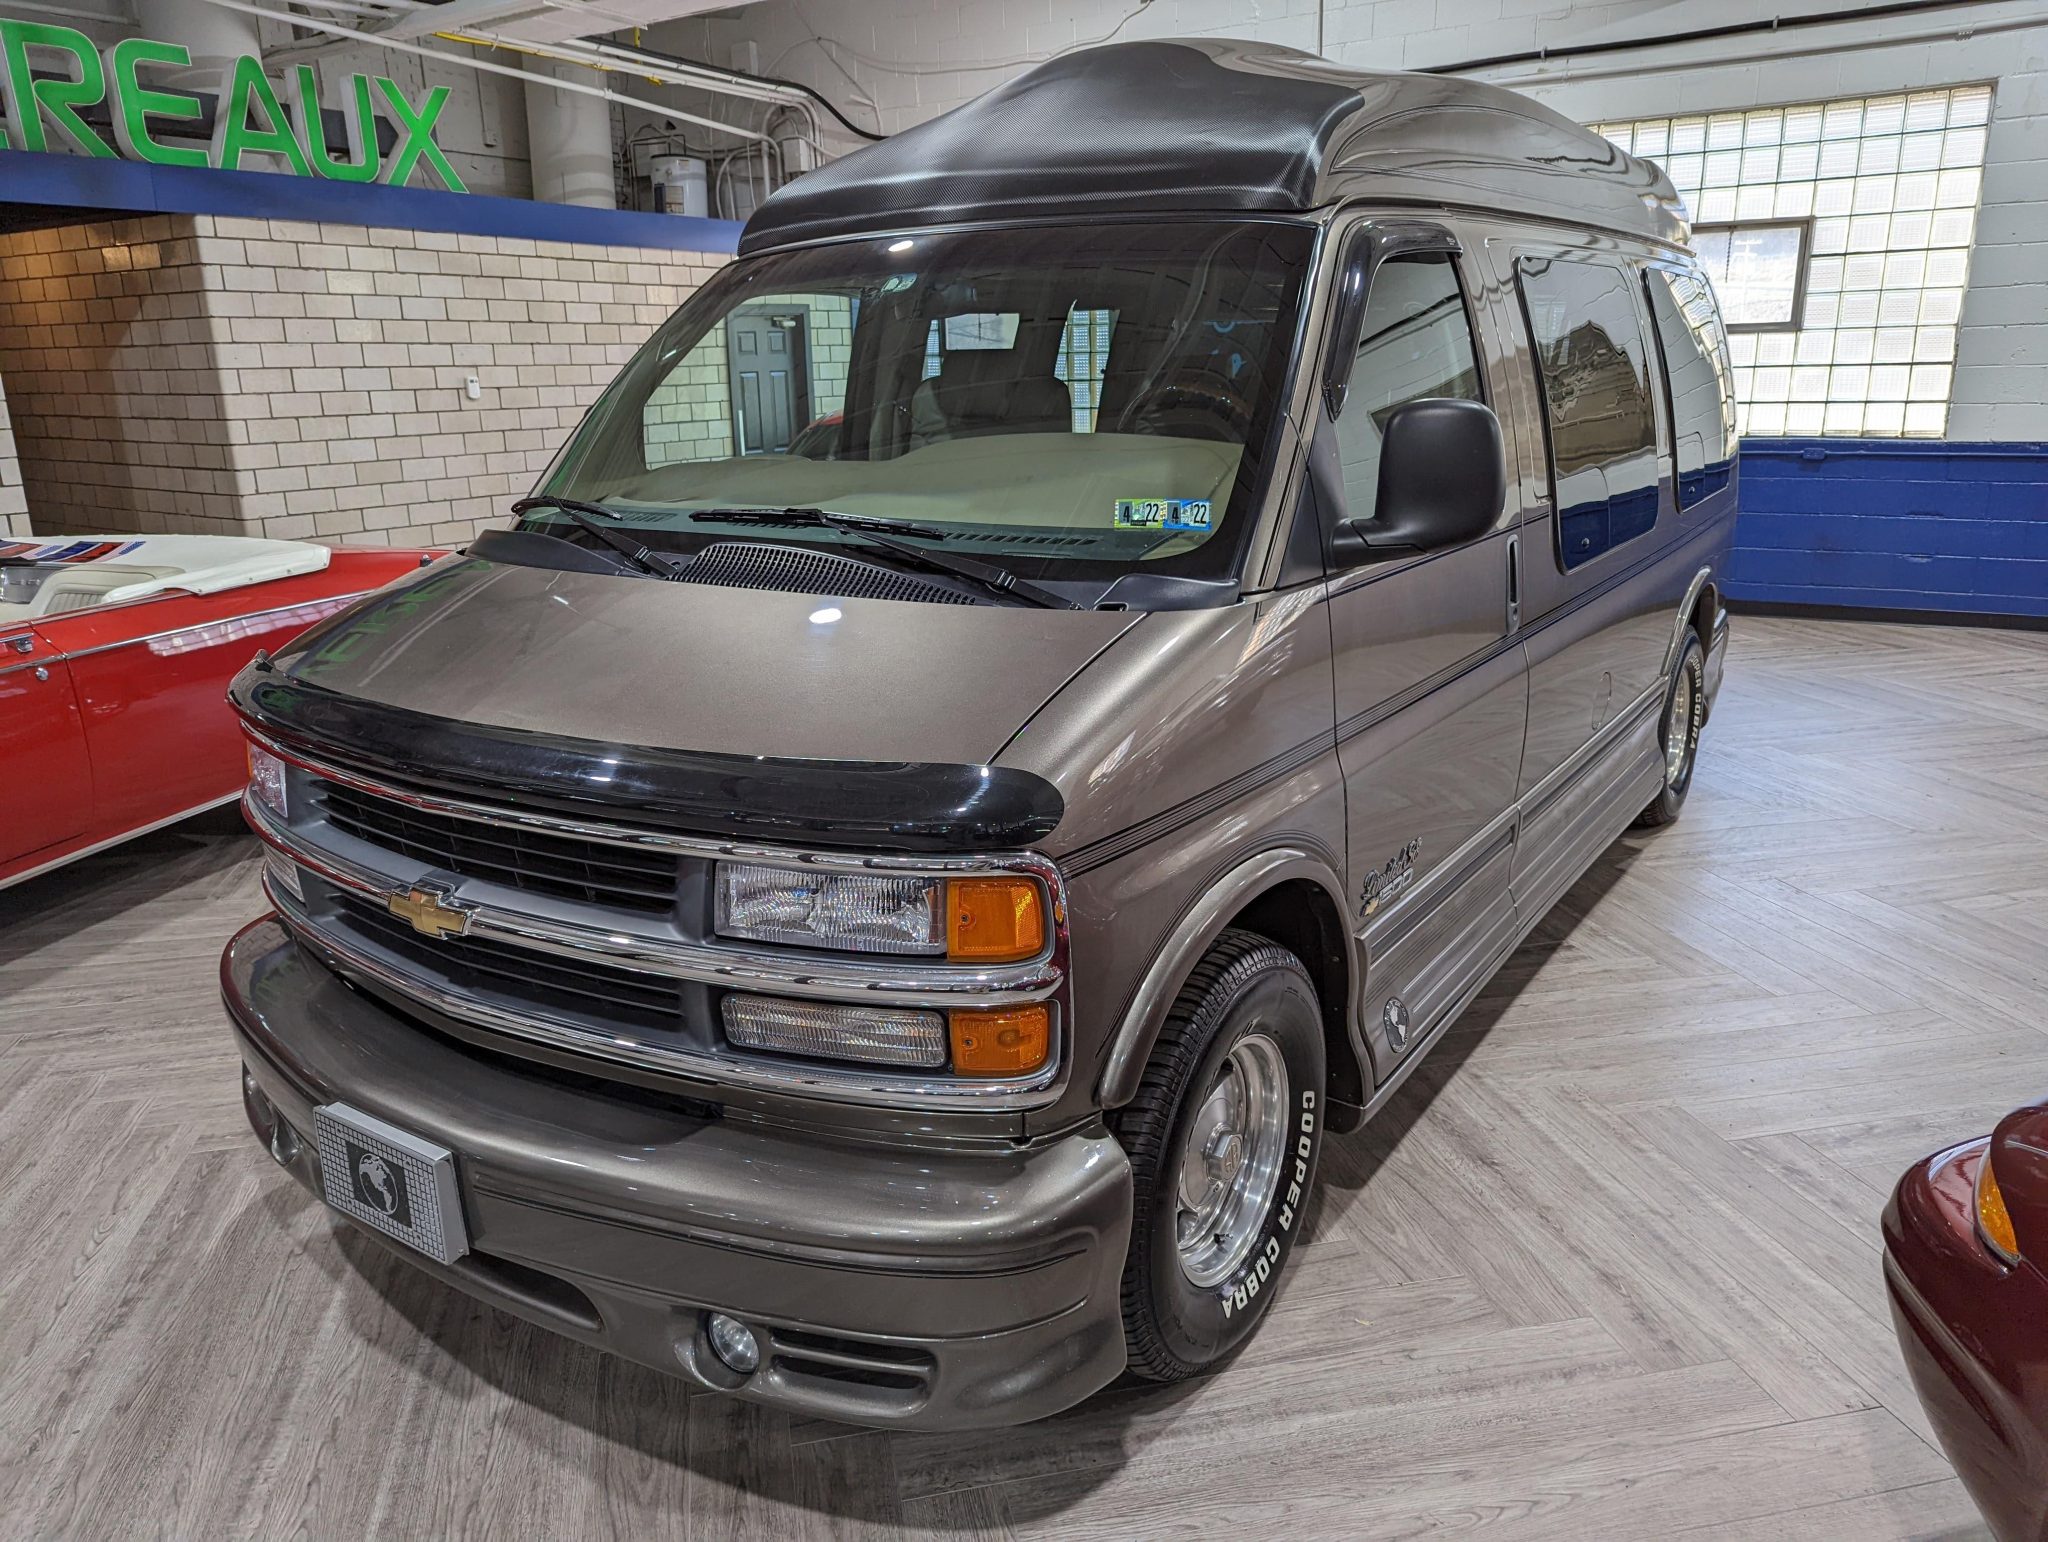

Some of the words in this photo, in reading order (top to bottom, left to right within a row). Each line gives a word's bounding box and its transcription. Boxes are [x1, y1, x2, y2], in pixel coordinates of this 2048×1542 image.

[0, 18, 469, 194] REAUX
[1123, 505, 1130, 523] 4
[1145, 503, 1160, 523] 22
[1172, 506, 1179, 524] 4
[1193, 504, 1207, 524] 22
[1690, 693, 1702, 749] COBRA
[1278, 1090, 1315, 1232] COOPER
[1221, 1236, 1280, 1319] COBRA
